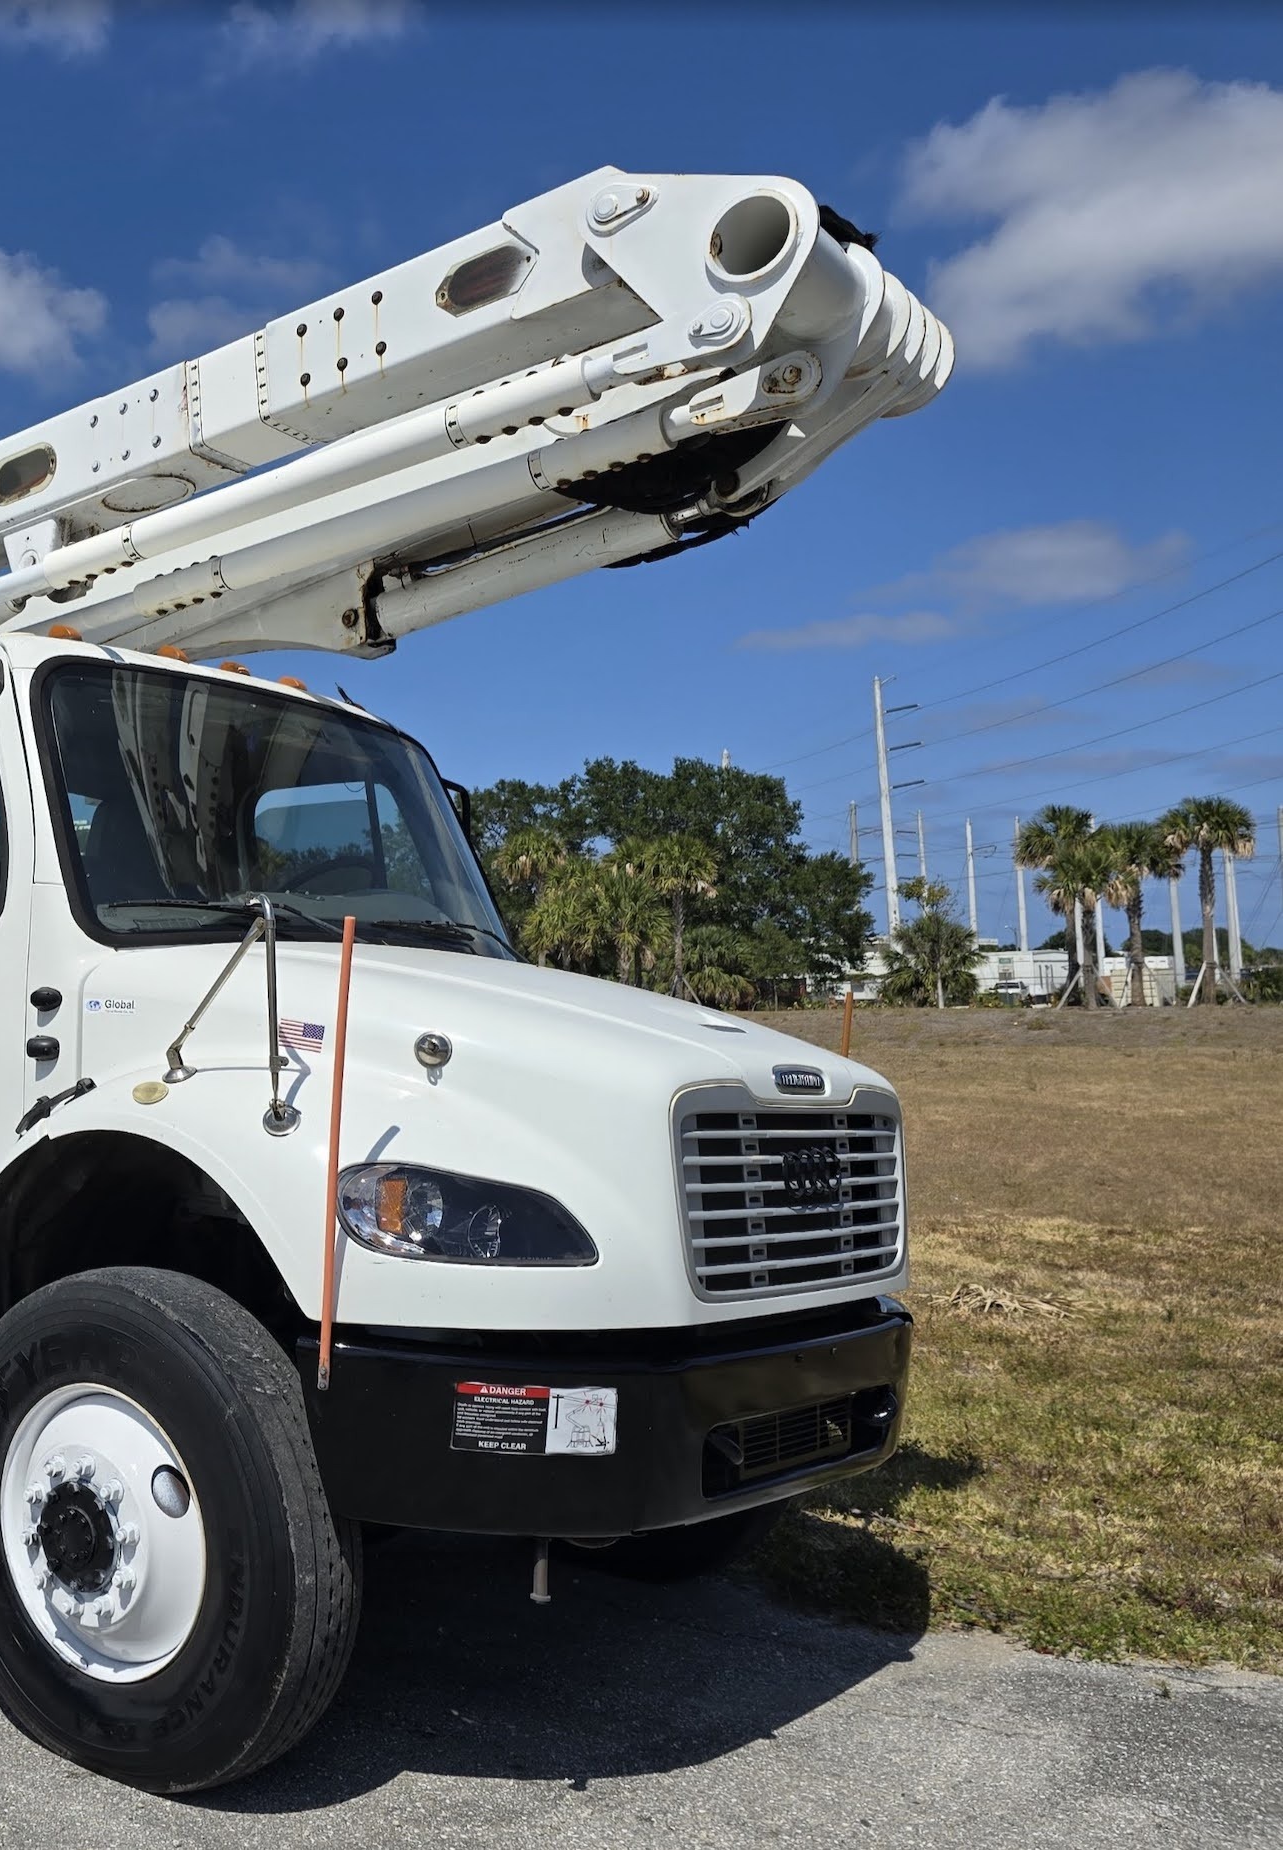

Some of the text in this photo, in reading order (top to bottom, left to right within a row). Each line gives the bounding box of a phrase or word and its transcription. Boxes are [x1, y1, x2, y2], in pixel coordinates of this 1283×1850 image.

[104, 999, 135, 1009] Global
[489, 1386, 527, 1396] DANGER
[474, 1396, 510, 1405] ELECTRICAL
[478, 1440, 527, 1450] KEEP CLEAR
